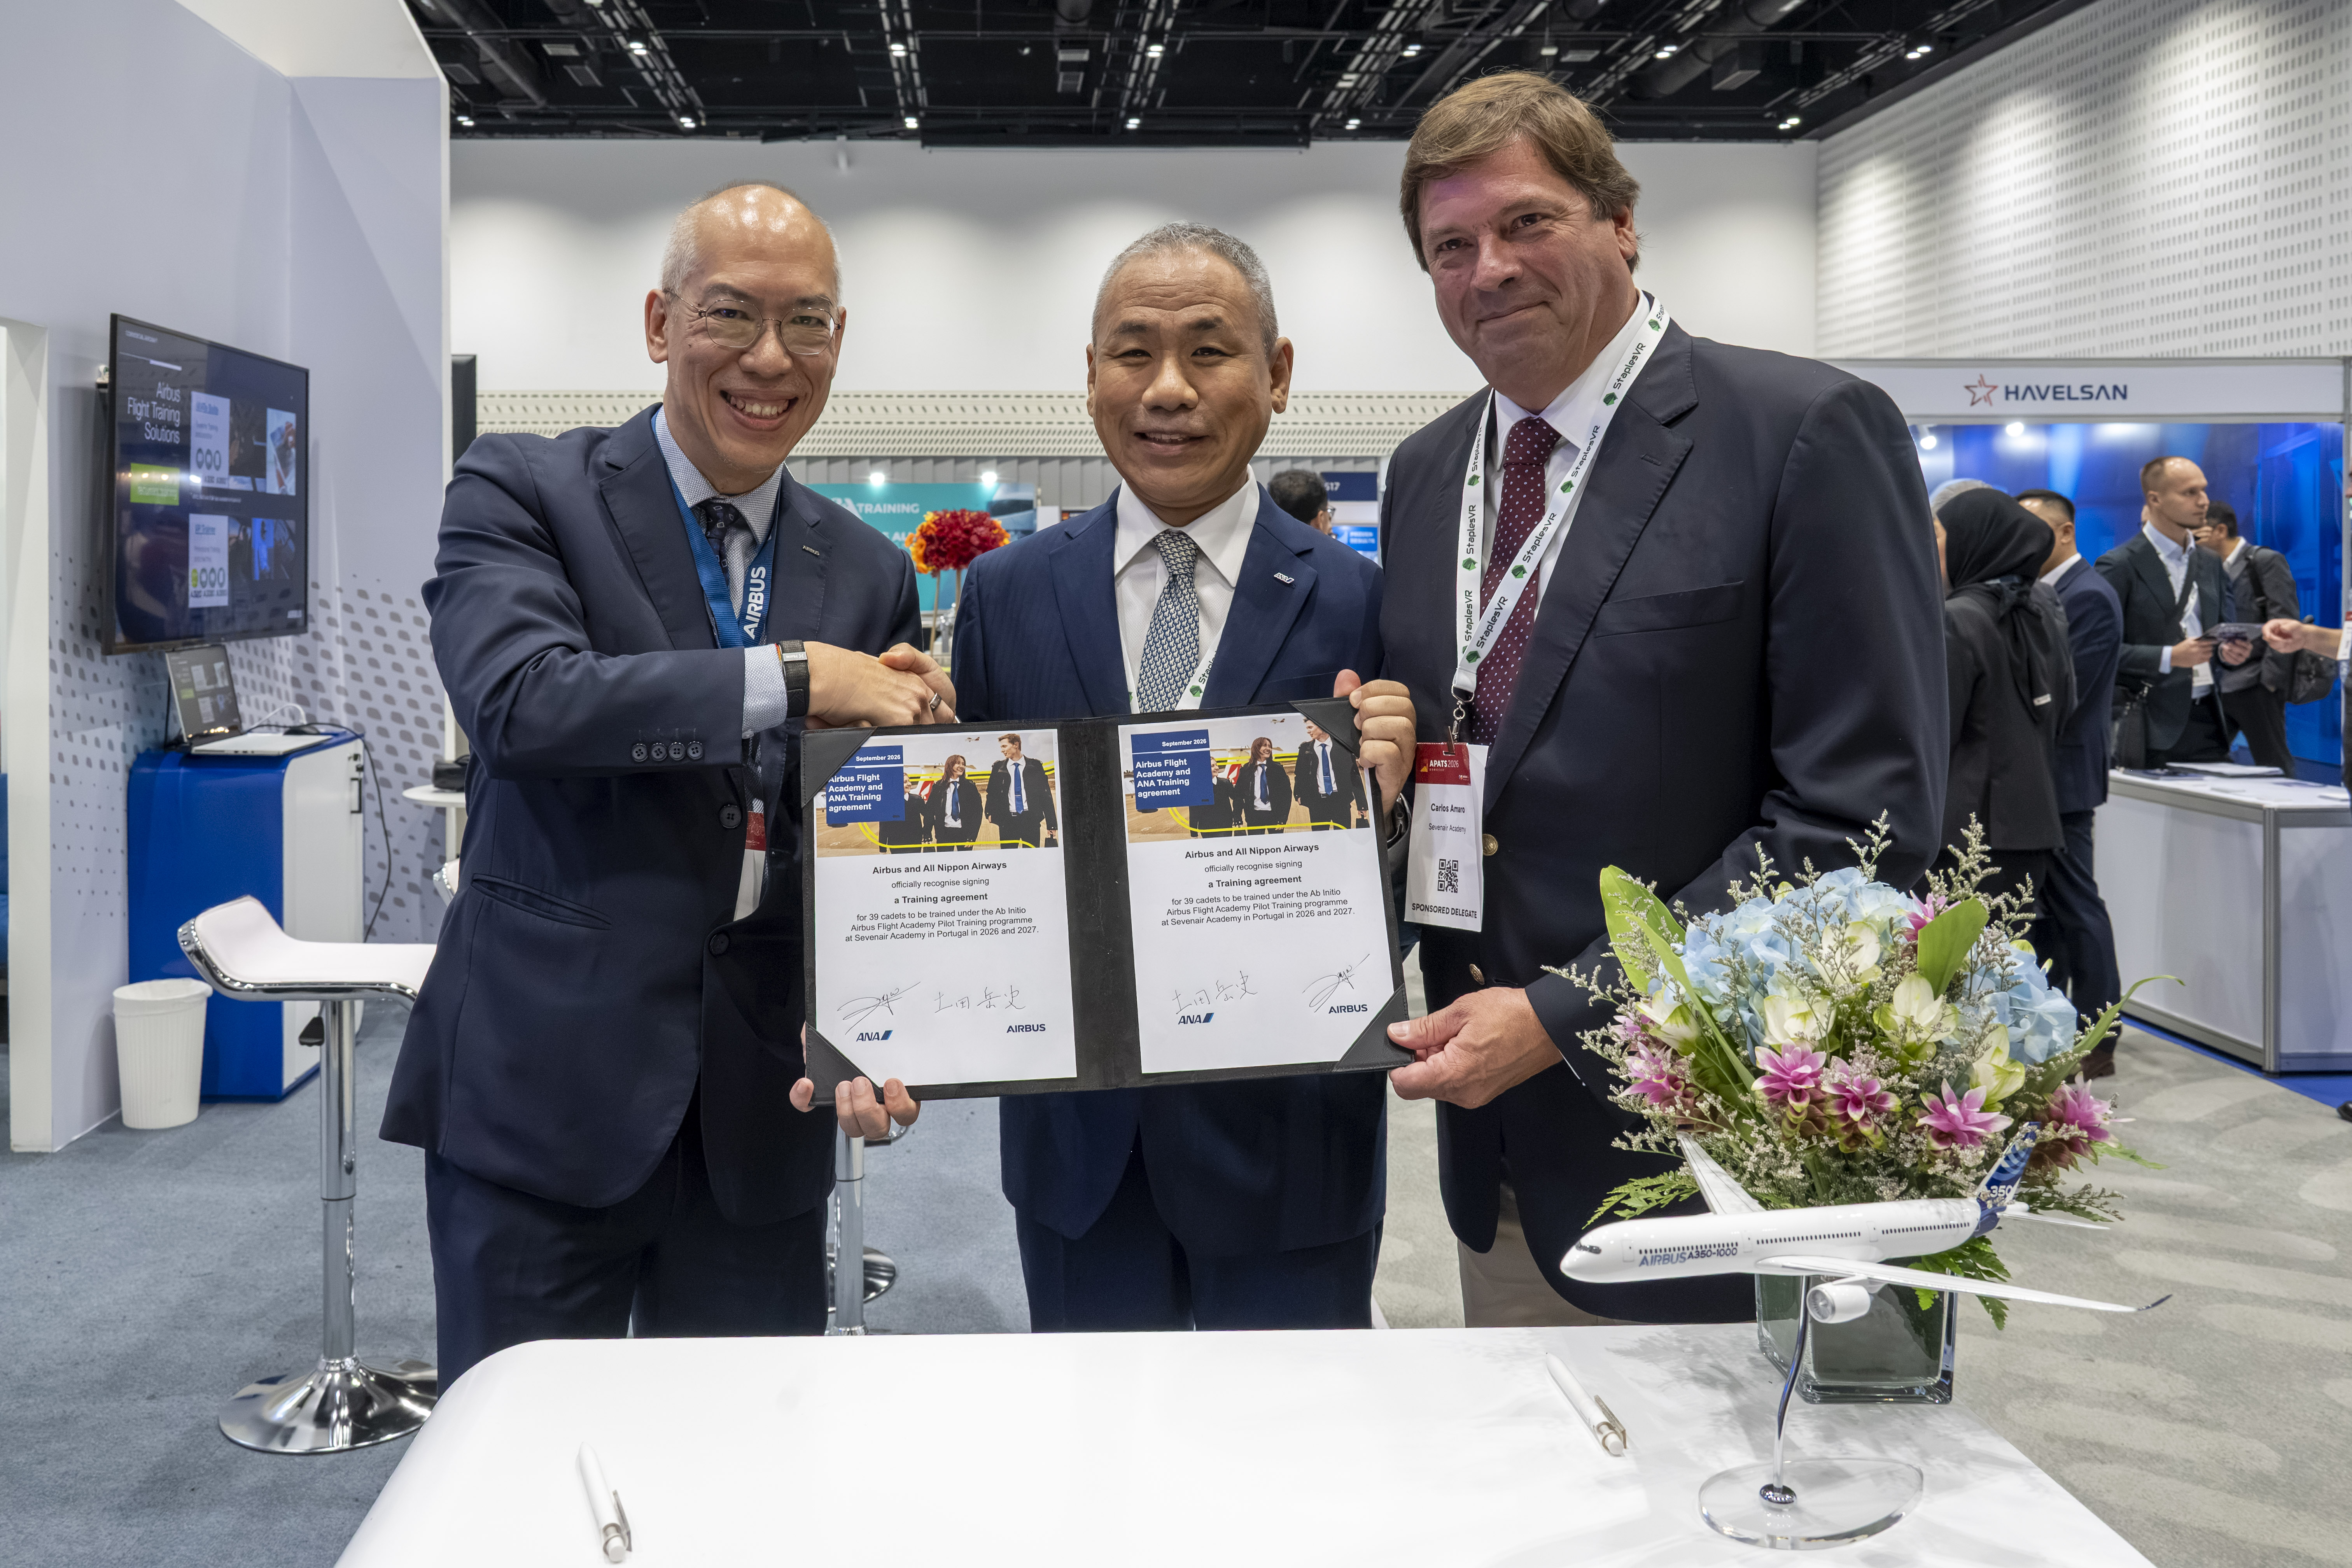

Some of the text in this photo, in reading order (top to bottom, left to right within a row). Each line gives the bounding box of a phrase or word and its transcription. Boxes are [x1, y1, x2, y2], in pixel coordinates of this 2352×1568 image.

[1613, 343, 1646, 389] StaplesVR
[156, 382, 180, 402] Airbus
[2005, 385, 2127, 400] HAVELSAN
[128, 397, 149, 421] Flight
[151, 401, 180, 427] Training
[145, 422, 180, 444] Solutions
[1572, 425, 1600, 477] StaplesVR
[856, 503, 920, 514] TRAINING
[1466, 504, 1476, 554] StaplesVR
[1522, 513, 1557, 563] StaplesVR
[802, 545, 819, 555] AIRBUS
[743, 566, 766, 640] AIRBUS
[1477, 596, 1508, 648] StaplesVR
[1164, 759, 1187, 767] Flight
[857, 774, 880, 782] Flight
[1138, 788, 1180, 798] agreement
[829, 803, 872, 813] agreement
[1431, 803, 1465, 813] Carlos Amaro
[1449, 825, 1466, 834] Academy
[1250, 847, 1281, 856] Nippon
[1284, 845, 1319, 853] Airways
[938, 864, 969, 872] Nippon
[971, 862, 1007, 870] Airways
[1237, 863, 1273, 871] recognise
[1276, 861, 1302, 869] signing
[891, 878, 989, 889] officially recognise signing
[1216, 879, 1251, 887] Training
[1255, 876, 1302, 886] agreement
[941, 893, 988, 903] agreement
[1304, 900, 1348, 908] programme
[1253, 912, 1284, 920] Portugal
[1412, 903, 1477, 919] SPONSORED DELEGATE
[878, 923, 898, 931] Flight
[989, 918, 1032, 926] programme
[937, 929, 968, 938] Portugal
[1328, 1004, 1368, 1014] AIRBUS
[1178, 1015, 1202, 1024] ANA
[1006, 1024, 1045, 1033] AIRBUS
[856, 1032, 880, 1041] ANA
[1639, 1247, 1737, 1267] AIRBUS A350-1000
